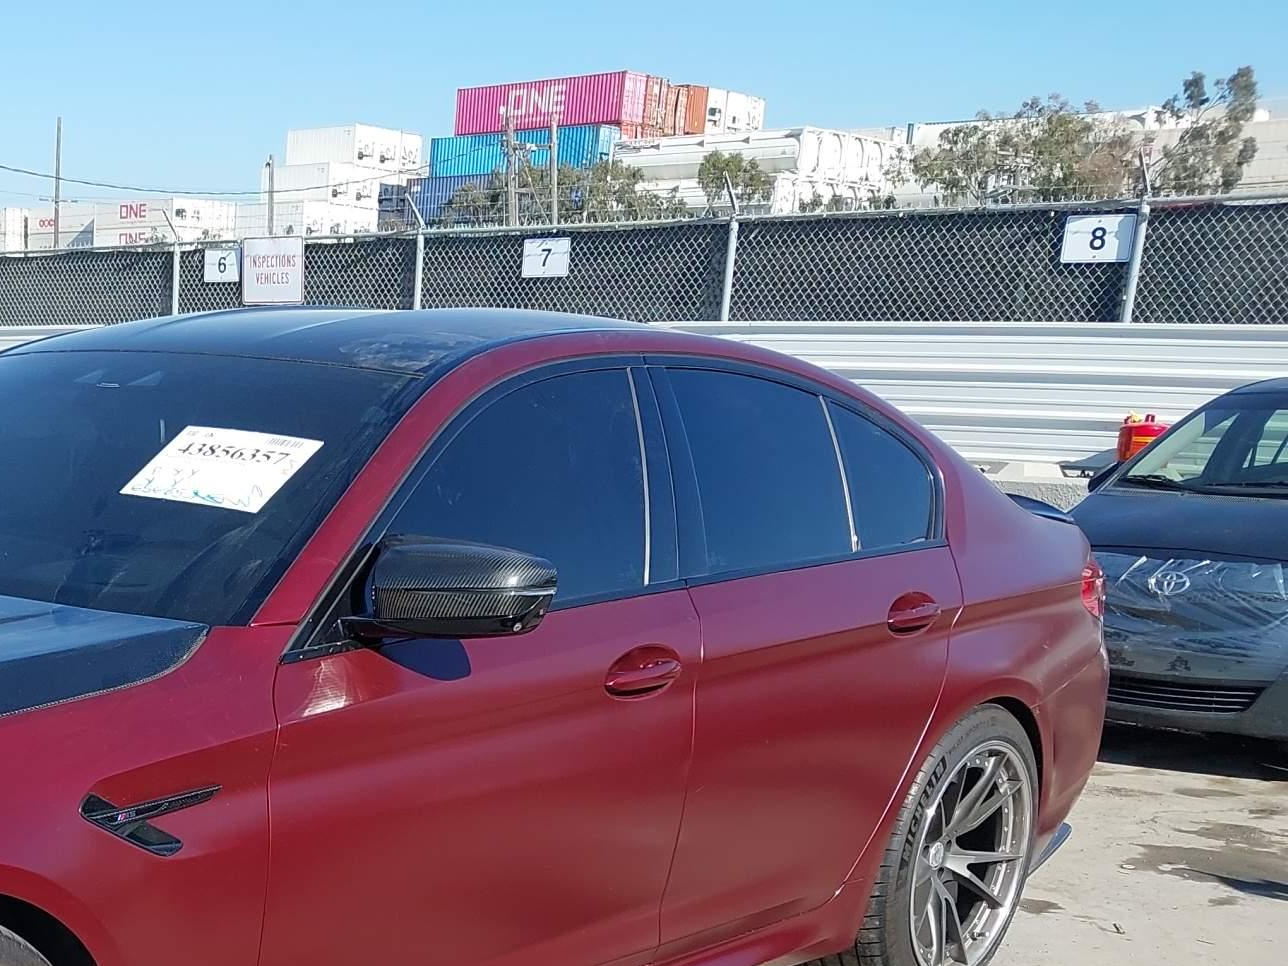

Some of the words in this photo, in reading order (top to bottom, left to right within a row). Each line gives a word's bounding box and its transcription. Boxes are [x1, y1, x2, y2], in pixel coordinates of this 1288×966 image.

[507, 83, 566, 116] ONE
[119, 203, 147, 220] ONE
[1089, 226, 1107, 250] 8
[217, 256, 227, 274] 6
[249, 255, 296, 269] INSPECTIONS
[541, 248, 552, 267] 7
[255, 272, 290, 285] VEHICLES
[177, 441, 291, 465] 43856357
